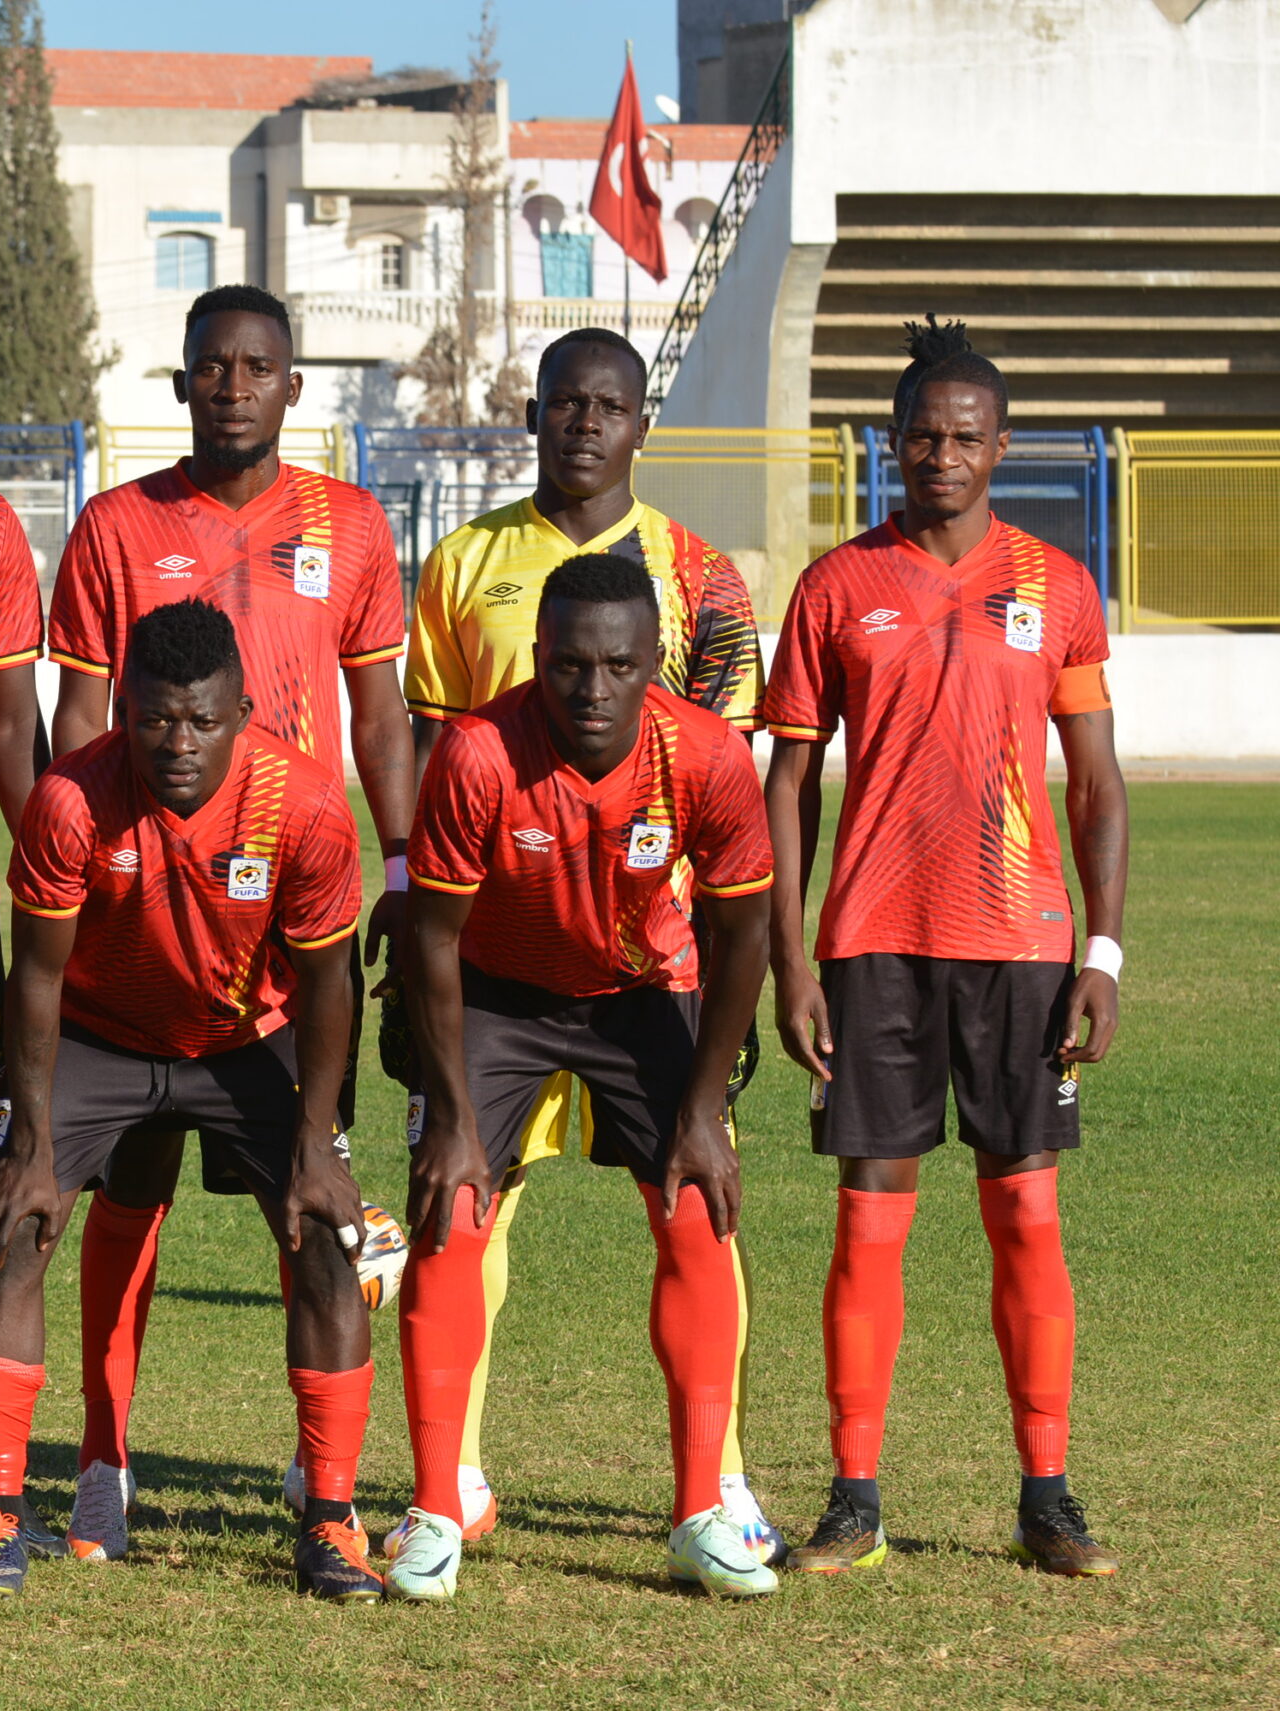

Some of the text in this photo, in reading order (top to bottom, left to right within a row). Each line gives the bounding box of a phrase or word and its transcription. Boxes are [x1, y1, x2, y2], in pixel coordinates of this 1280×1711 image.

[159, 571, 192, 580] umbro
[300, 583, 322, 594] FUFA
[486, 598, 518, 608] umbro
[864, 624, 898, 635] umbro
[1011, 636, 1033, 647] FUFA
[515, 842, 549, 853] umbro
